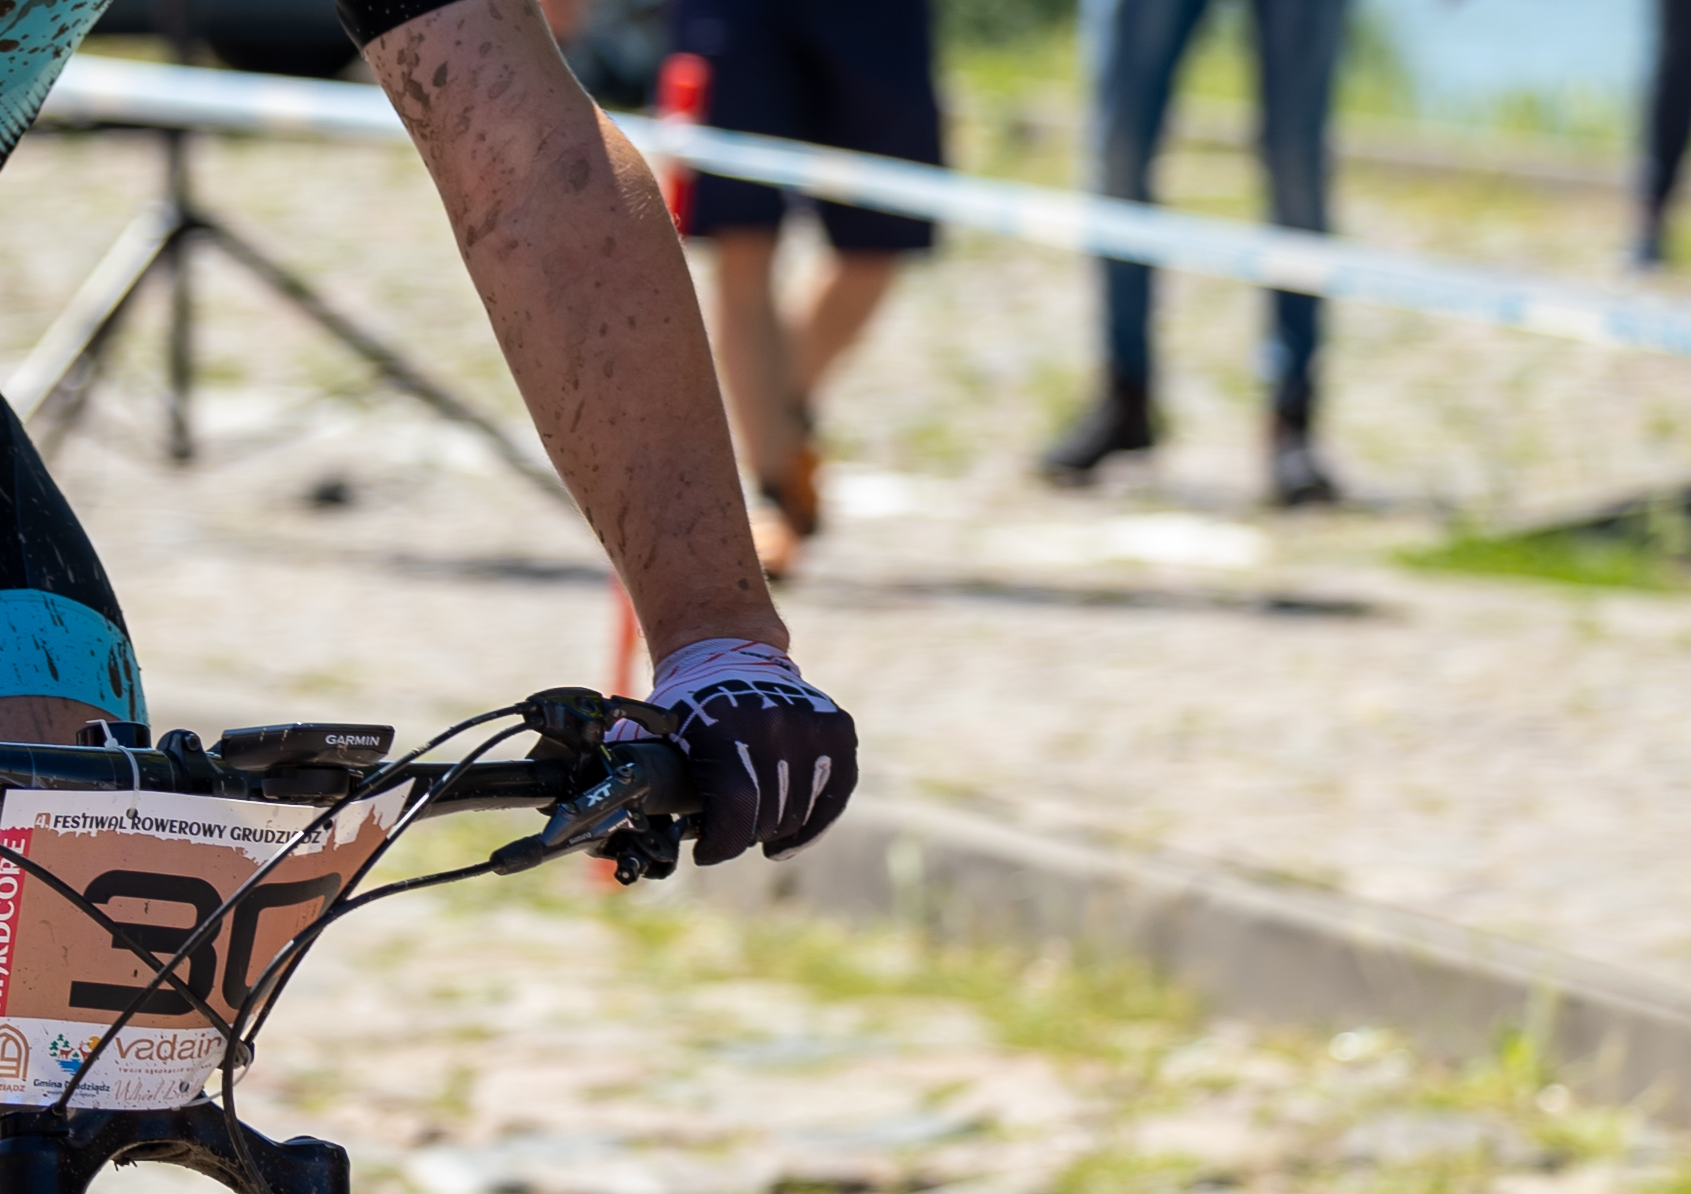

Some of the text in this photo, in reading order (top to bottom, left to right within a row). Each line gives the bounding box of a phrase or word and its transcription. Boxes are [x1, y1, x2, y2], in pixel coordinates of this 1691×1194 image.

[325, 733, 380, 747] GARMIN
[586, 783, 612, 807] XT
[53, 812, 128, 831] FESTIWAL
[130, 813, 227, 839] ROWEROWY
[33, 1078, 63, 1088] Gmina
